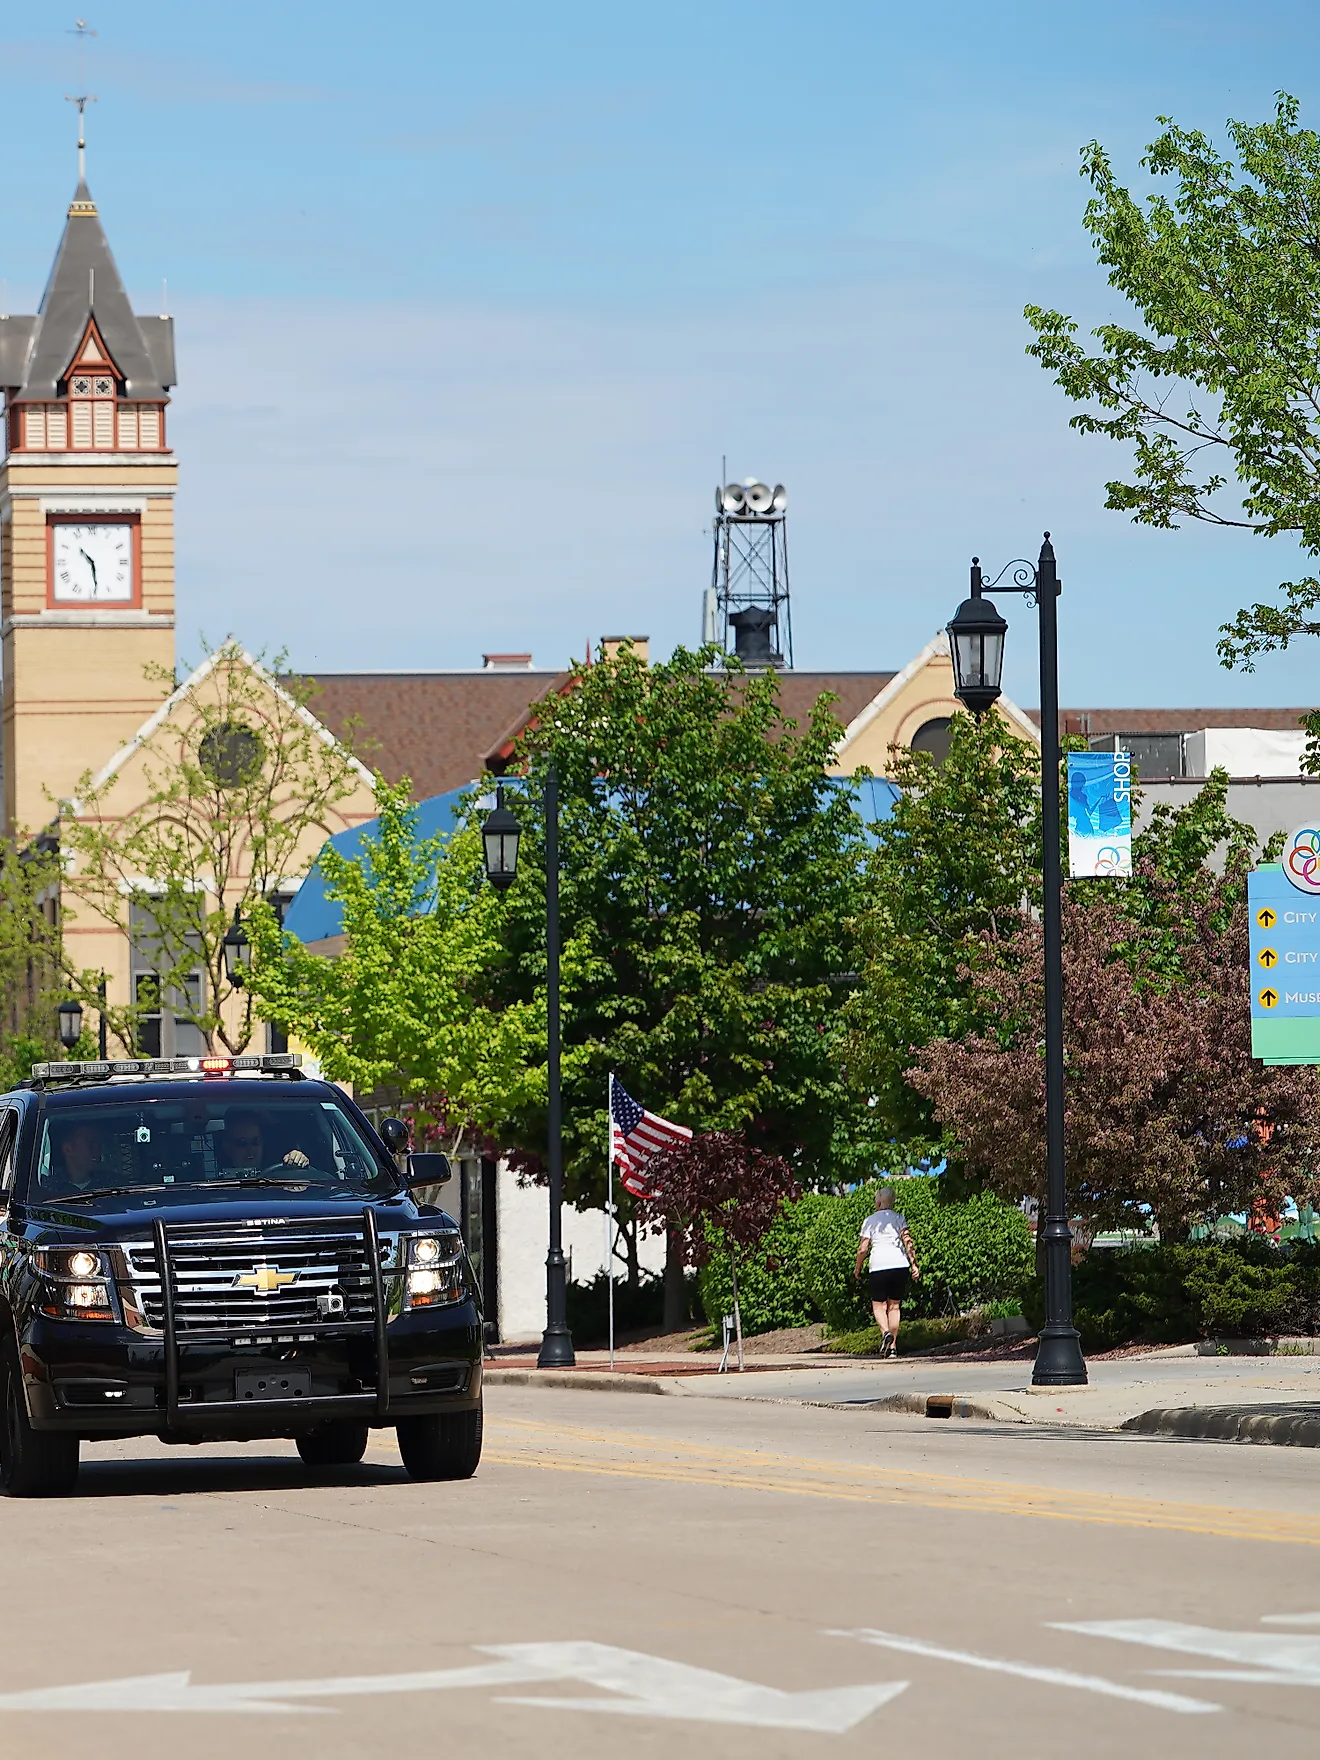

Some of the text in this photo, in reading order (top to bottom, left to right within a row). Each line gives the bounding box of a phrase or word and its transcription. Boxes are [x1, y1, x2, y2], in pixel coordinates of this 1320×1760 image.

[1113, 751, 1130, 803] SHOP
[1283, 911, 1317, 924] CITY
[1285, 951, 1318, 964] CITY
